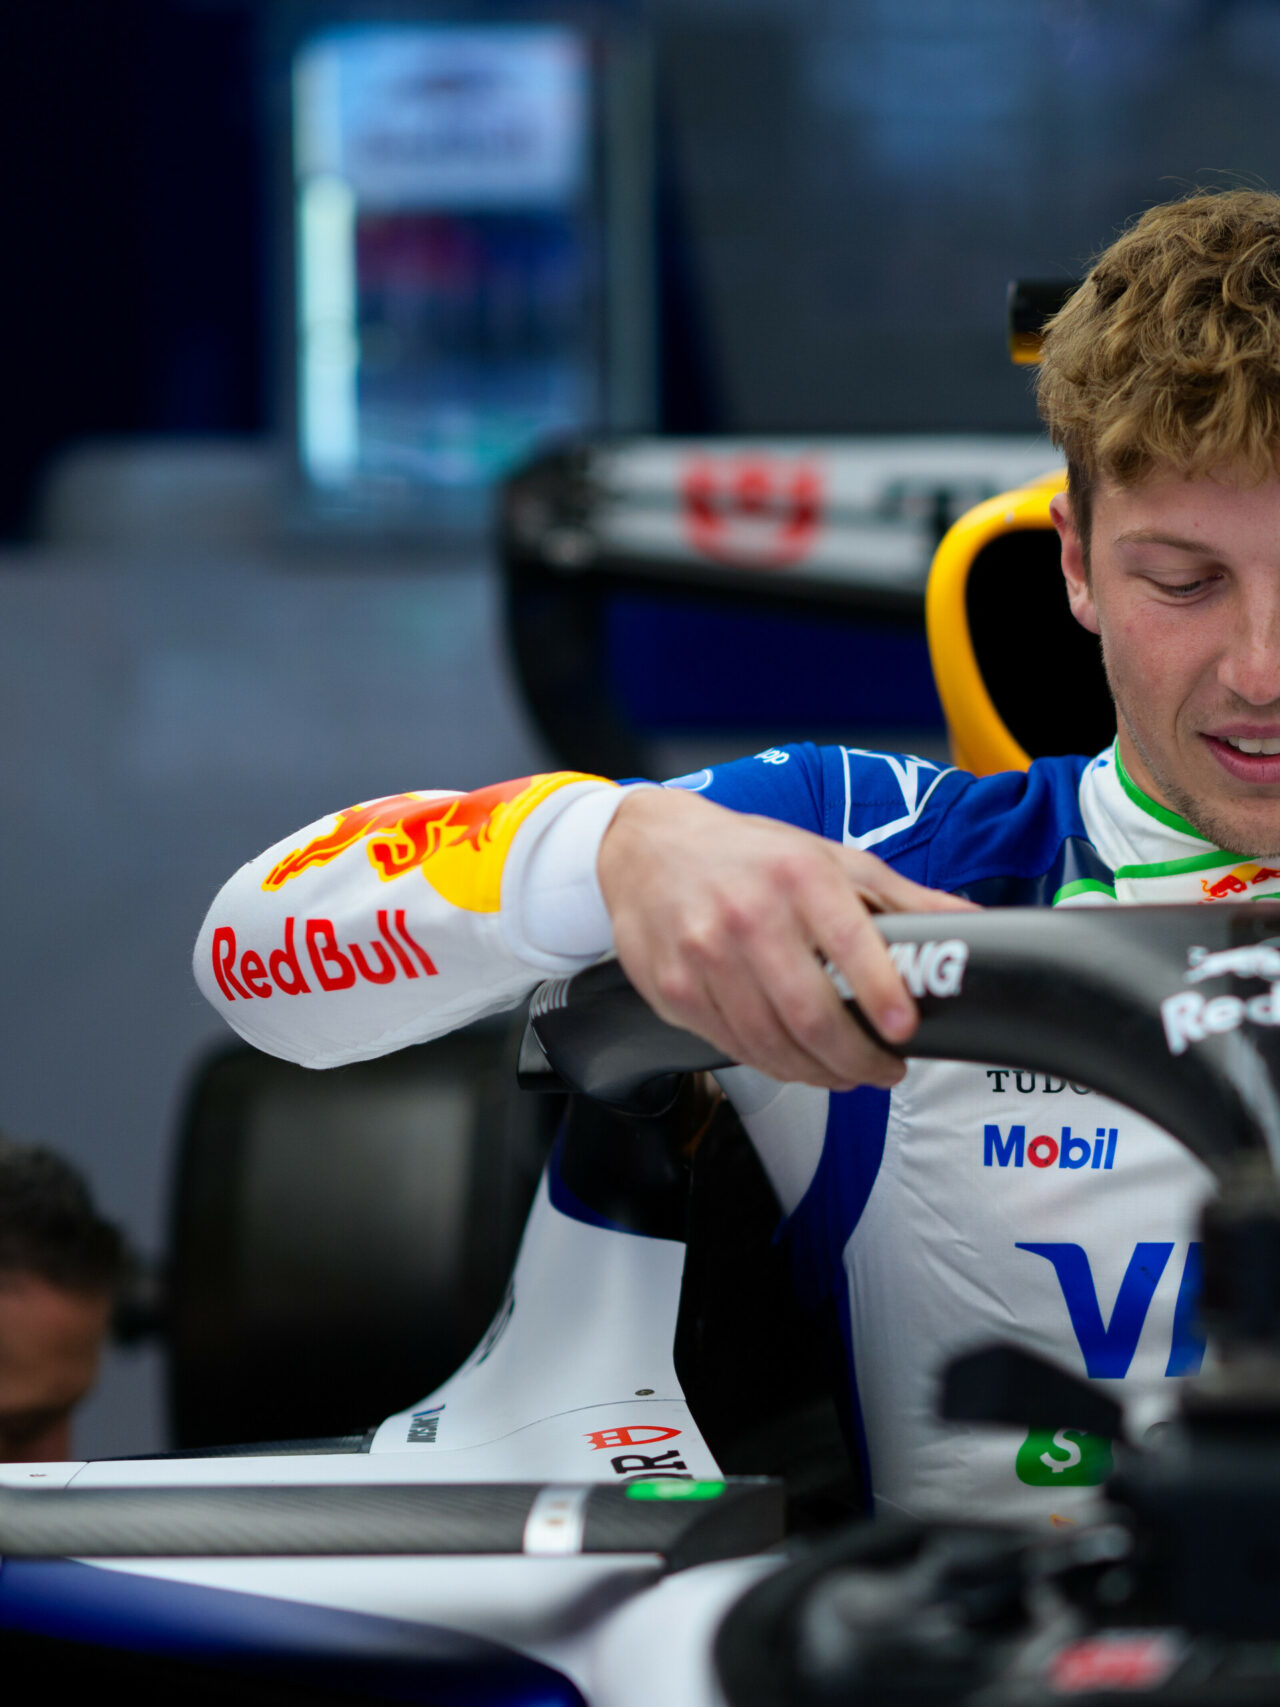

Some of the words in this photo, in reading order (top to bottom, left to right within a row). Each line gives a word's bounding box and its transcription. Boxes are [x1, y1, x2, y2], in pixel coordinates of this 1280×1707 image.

[212, 916, 312, 1002] Red
[305, 909, 439, 992] Bull
[983, 1124, 1119, 1170] Mobil
